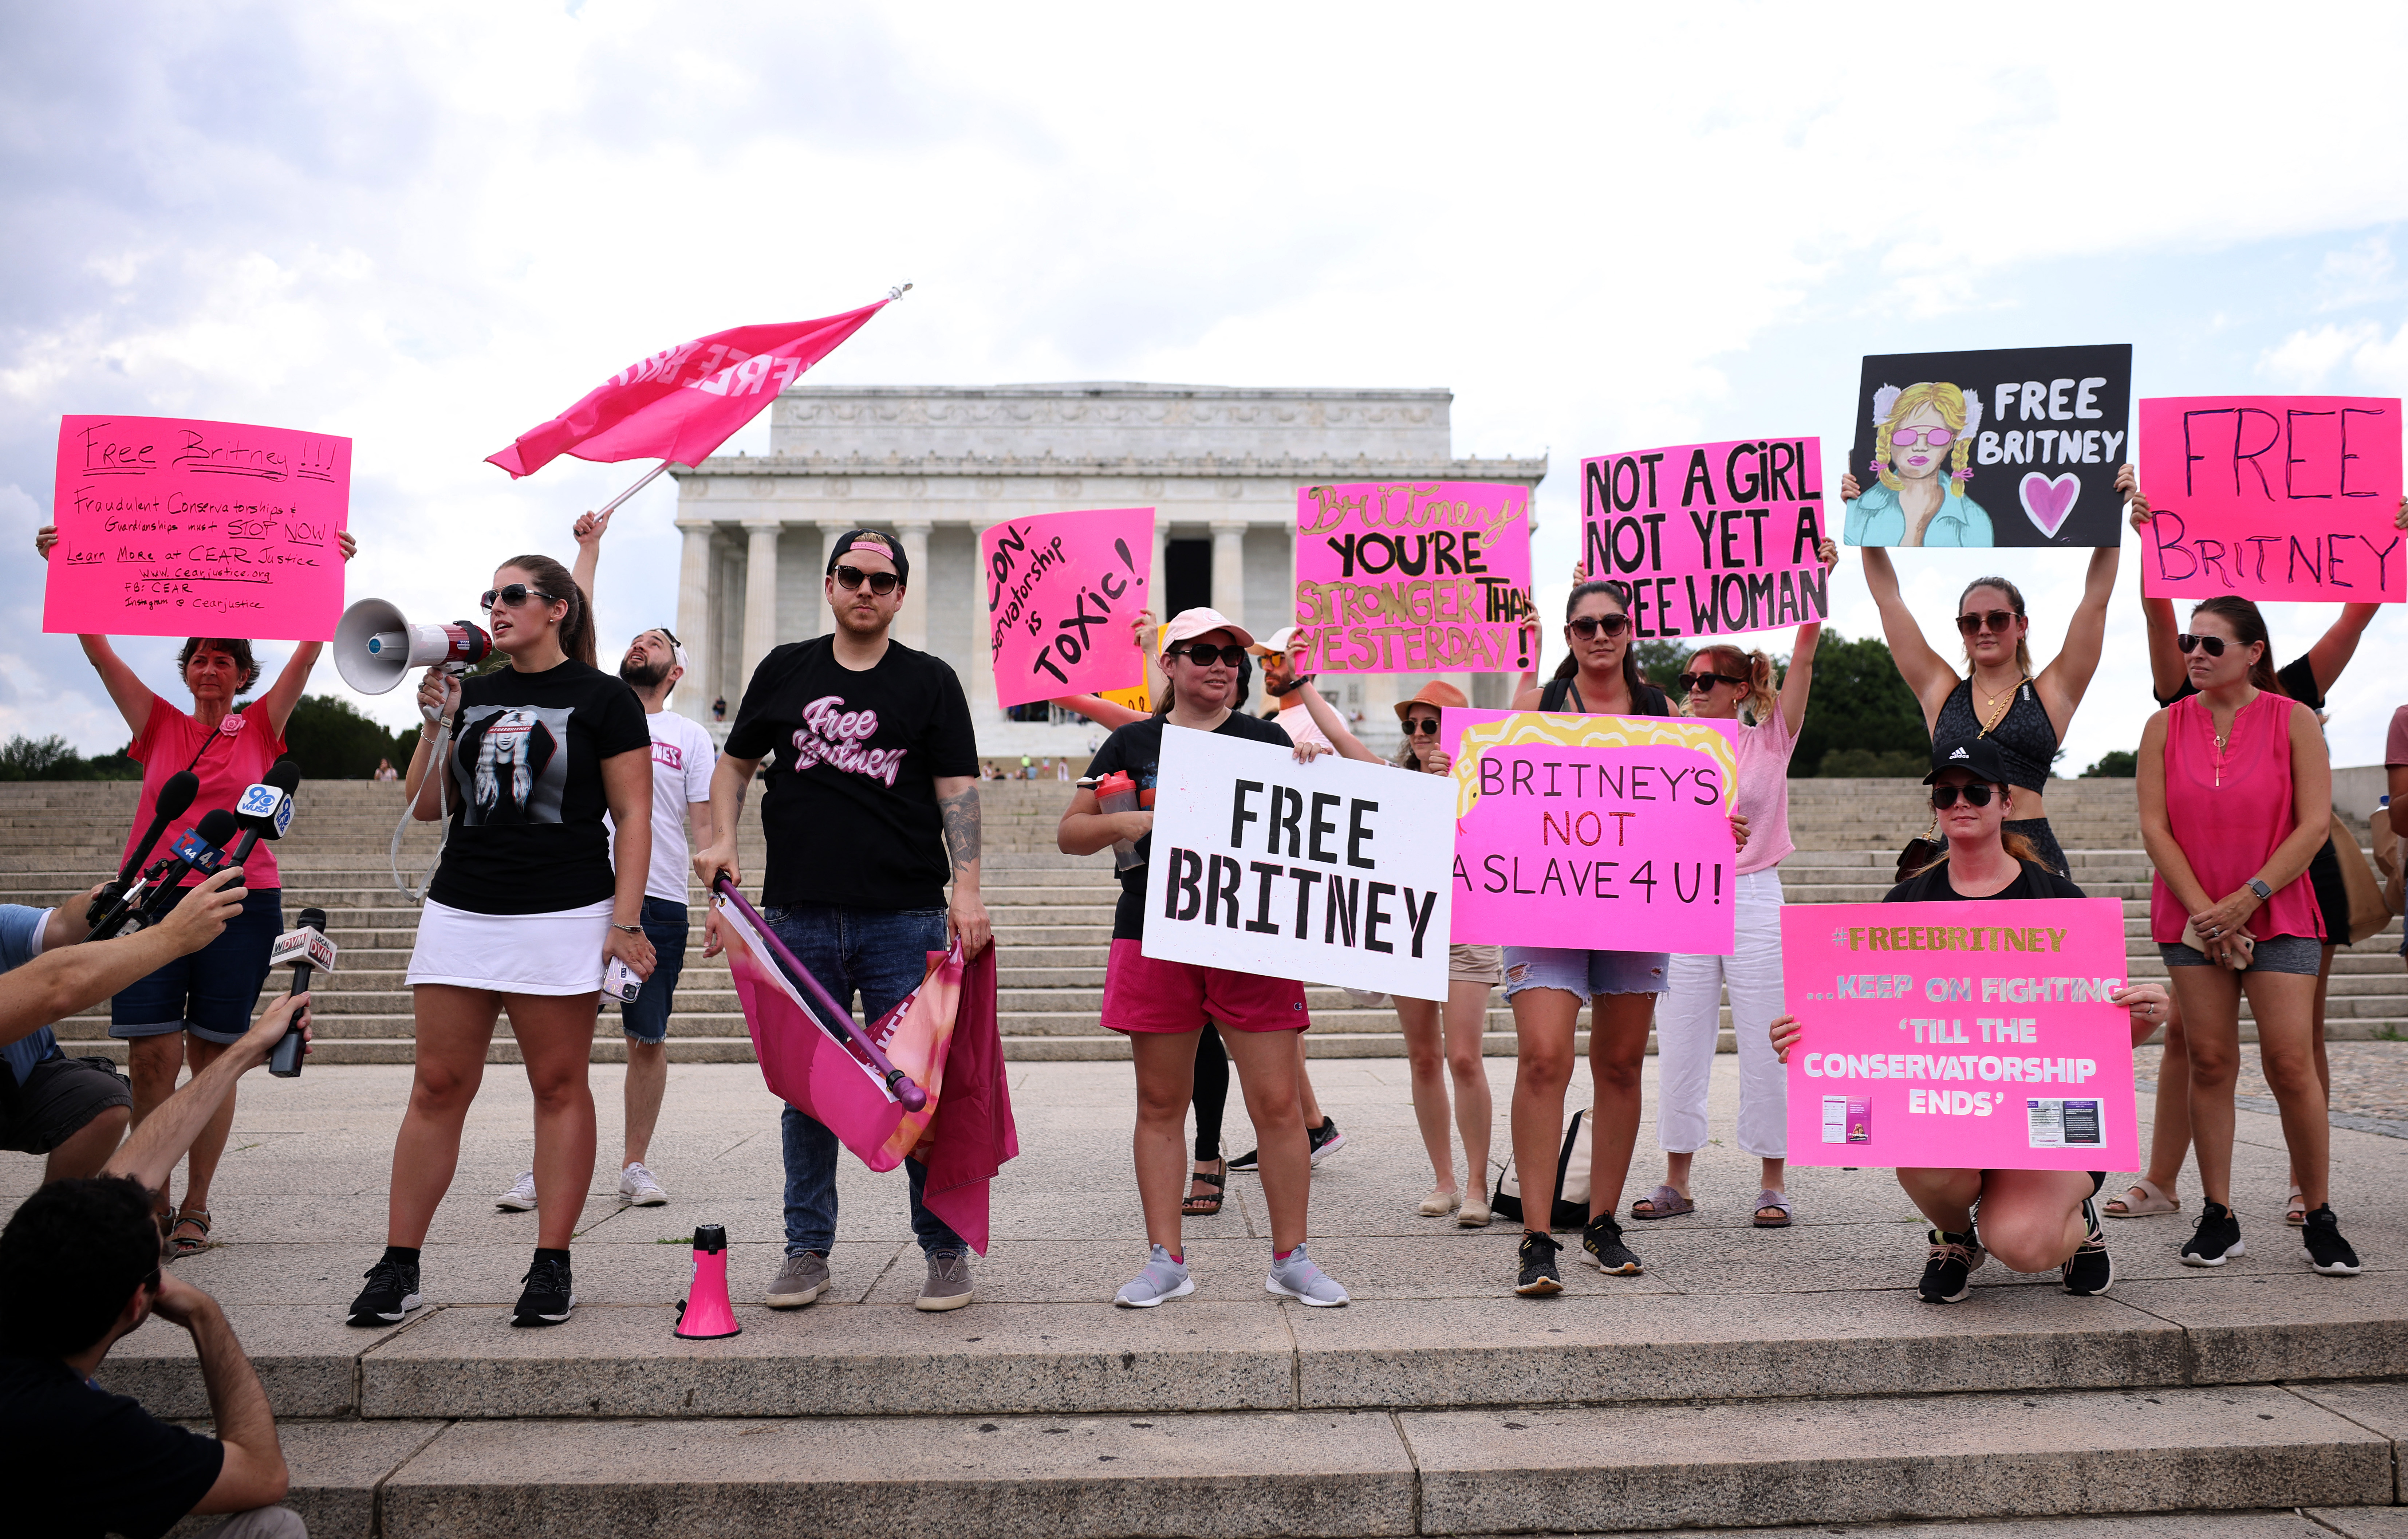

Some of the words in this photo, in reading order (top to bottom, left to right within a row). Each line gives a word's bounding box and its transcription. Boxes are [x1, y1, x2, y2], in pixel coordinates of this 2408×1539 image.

[1995, 377, 2107, 421] FREE
[172, 430, 288, 482] Britney
[1977, 430, 2124, 465] BRITNEY
[2184, 408, 2385, 502] FREE
[1586, 453, 1664, 516] NOT
[1681, 449, 1717, 507] A
[74, 485, 159, 514] Fraudulent
[105, 516, 178, 535] Guardianships
[188, 521, 217, 531] must
[228, 519, 277, 537] STOP
[1299, 483, 1526, 549] Britney
[67, 541, 106, 562] Learn
[165, 550, 182, 560] at
[188, 546, 252, 564] CEAR
[259, 546, 320, 567] Justice
[1327, 530, 1488, 577] YOU'RE
[1587, 513, 1666, 577] NOT
[1689, 509, 1769, 569] YET
[1792, 507, 1823, 564] A
[2151, 510, 2400, 591] BRITNEY
[125, 582, 145, 593] FB:
[151, 582, 193, 593] CEAR
[1296, 578, 1482, 626] STRONGER
[1620, 577, 1681, 638] EE
[1685, 567, 1828, 634] WOMAN
[125, 597, 168, 610] Instagram
[1025, 610, 1042, 637] is
[802, 695, 878, 741] Free
[651, 743, 678, 765] NEY
[1481, 758, 1719, 806] BRITNEY'S
[242, 803, 269, 814] WUSA
[1230, 778, 1379, 870] FREE
[1543, 811, 1636, 847] NOT
[184, 848, 197, 859] 44
[198, 851, 214, 865] 4
[1452, 854, 1473, 892] A
[1483, 854, 1619, 899] SLAVE
[1629, 860, 1658, 904] 4
[1164, 847, 1438, 959] BRITNEY
[275, 934, 304, 953] WDVM
[310, 940, 330, 965] DVM
[315, 934, 330, 949] LOCAL
[1831, 926, 2068, 953] #FREEBRITNEY
[321, 961, 329, 969] .com
[1925, 977, 1972, 1002] ON
[1982, 977, 2123, 1003] FIGHTING
[1899, 1018, 1969, 1044] 'TILL
[1976, 1018, 2037, 1043] THE
[1803, 1052, 2096, 1084] CONSERVATORSHIP
[1908, 1089, 2004, 1117] ENDS'
